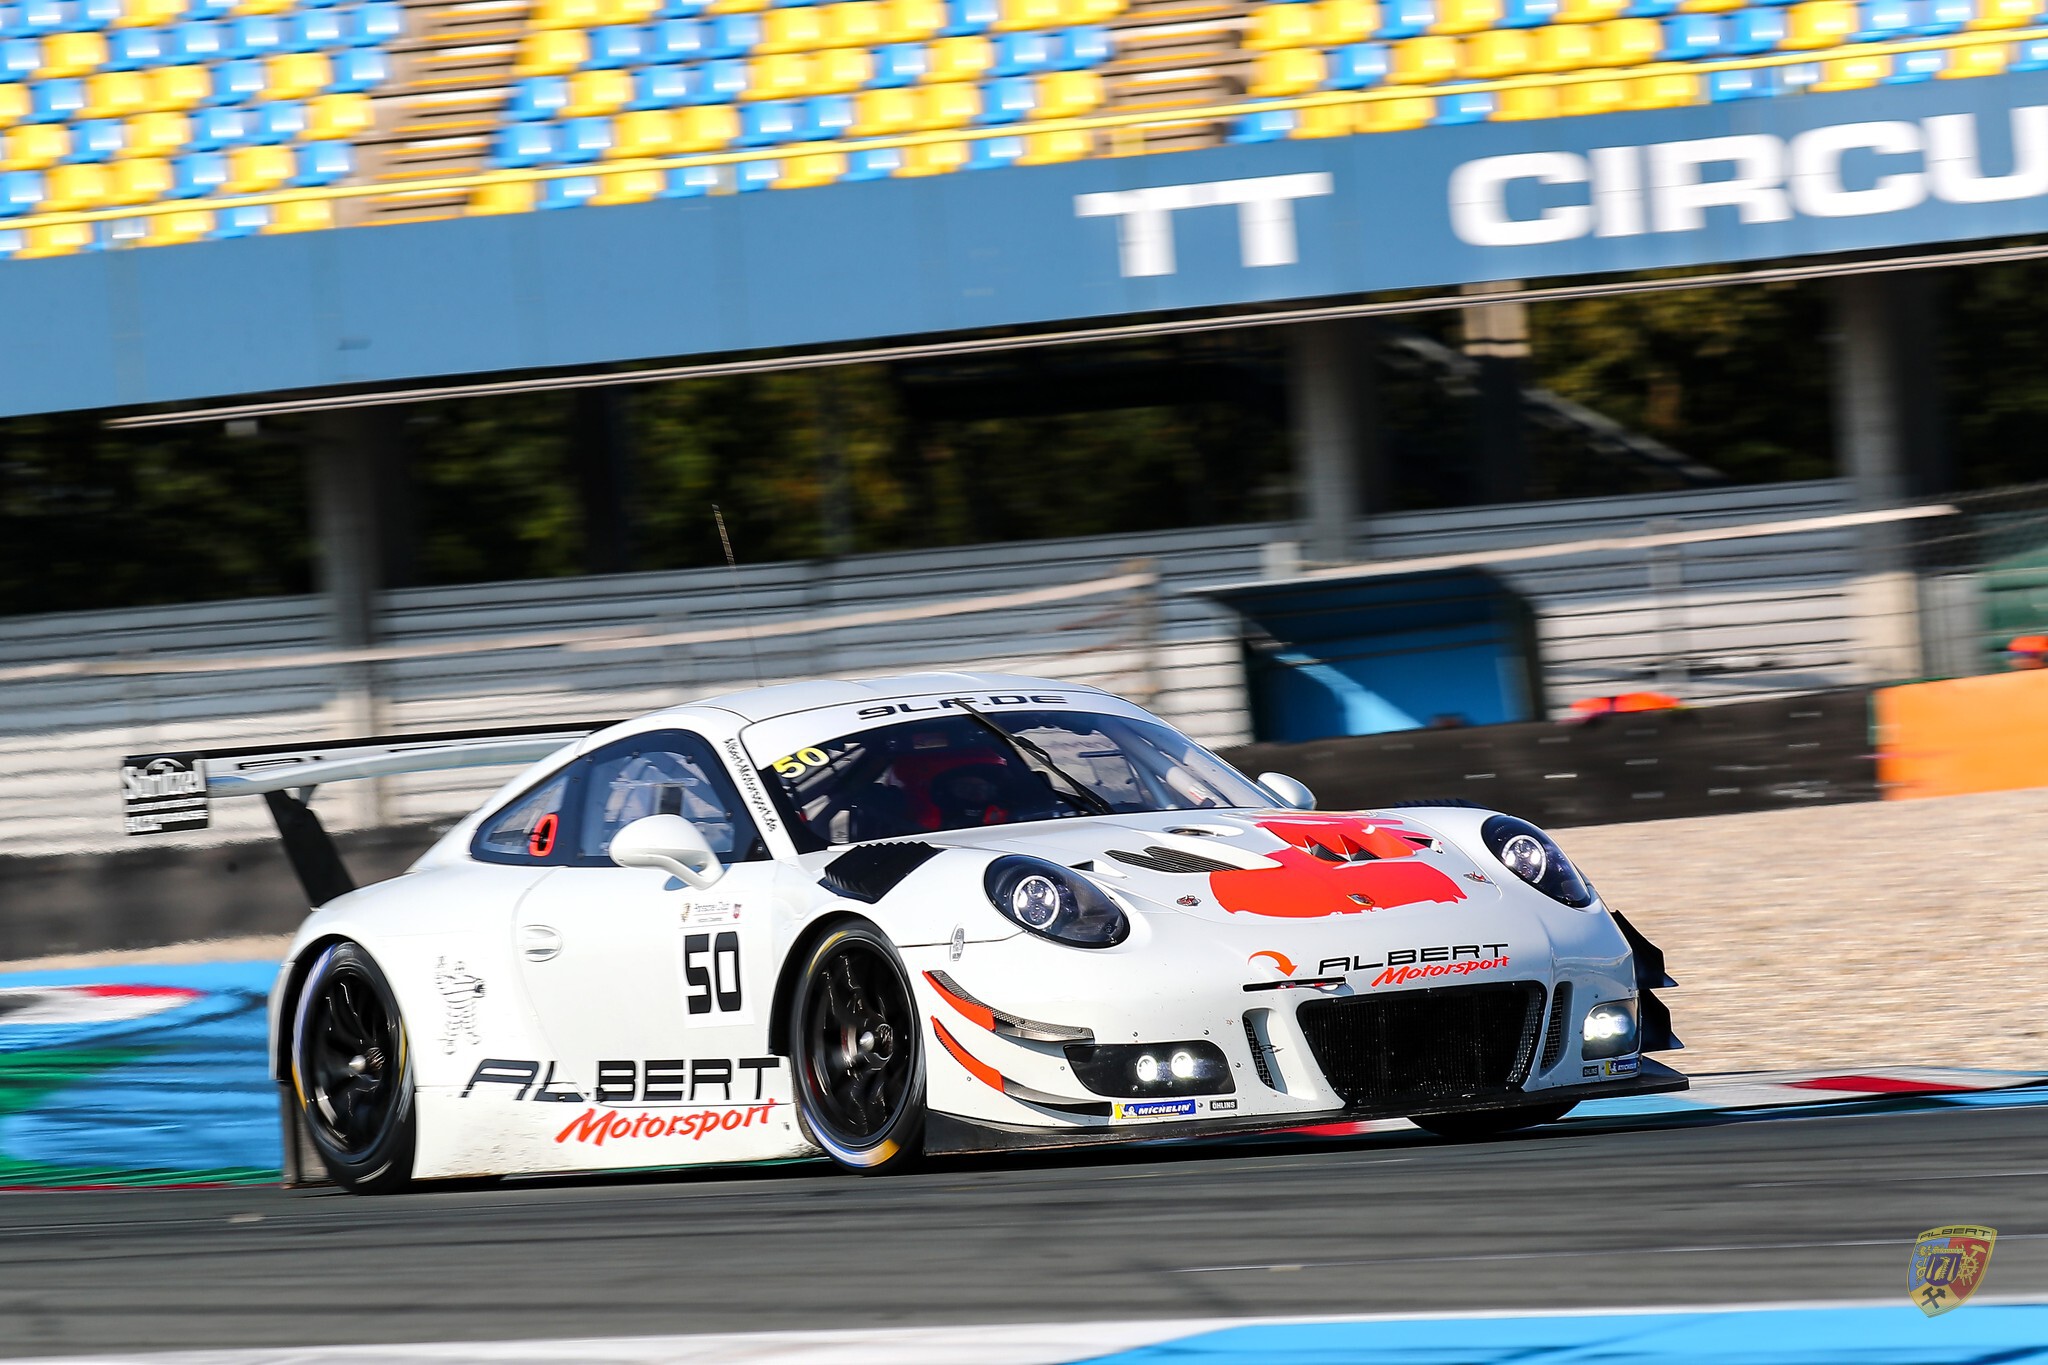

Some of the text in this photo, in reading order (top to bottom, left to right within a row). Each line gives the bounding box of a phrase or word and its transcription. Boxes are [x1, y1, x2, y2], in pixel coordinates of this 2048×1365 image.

[1075, 105, 2048, 278] TT CIRCU
[773, 746, 830, 779] 50
[684, 930, 742, 1015] 50
[1317, 943, 1509, 975] ALBERT
[1371, 955, 1511, 987] Motorsport
[457, 1057, 780, 1102] ALBERT
[553, 1098, 778, 1146] Motorsport
[1138, 1103, 1192, 1115] MICHELIN
